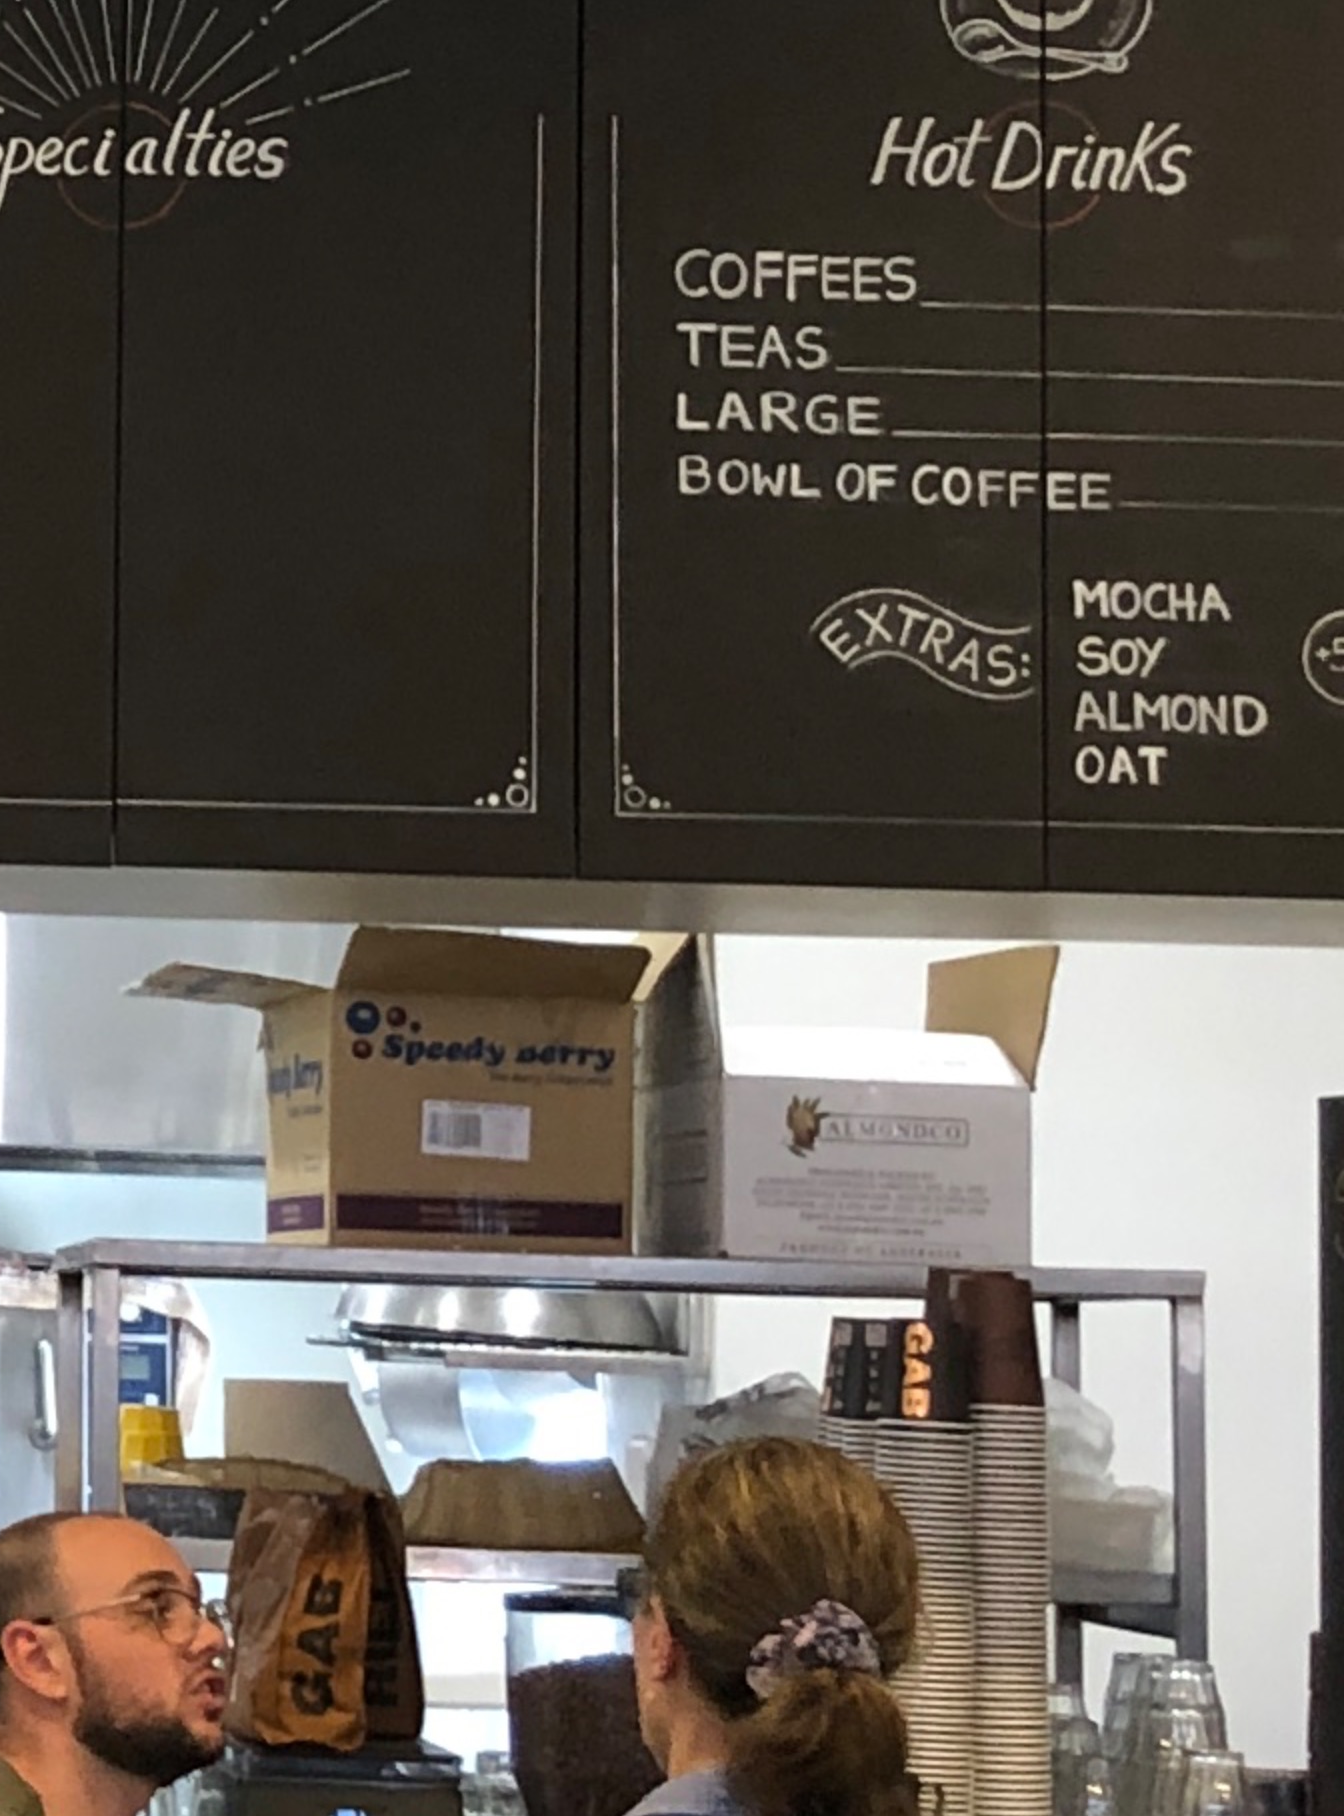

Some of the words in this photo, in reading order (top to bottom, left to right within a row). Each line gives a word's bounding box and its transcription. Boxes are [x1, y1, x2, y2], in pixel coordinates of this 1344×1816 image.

[870, 116, 993, 189] Hot
[675, 248, 917, 302] COFFEES
[675, 321, 829, 371] TEAS
[676, 391, 882, 436] LARGE
[677, 454, 820, 498] BOWL
[835, 461, 898, 504] OF
[912, 464, 1112, 510] COFFEE
[1072, 579, 1232, 622] MOCHA
[819, 604, 1031, 688] EXTRAS:
[1076, 636, 1167, 678] SOY
[1074, 691, 1268, 736] ALMOND
[1075, 745, 1168, 785] OAT
[381, 1034, 506, 1067] Speedy
[901, 1321, 936, 1419] GAB
